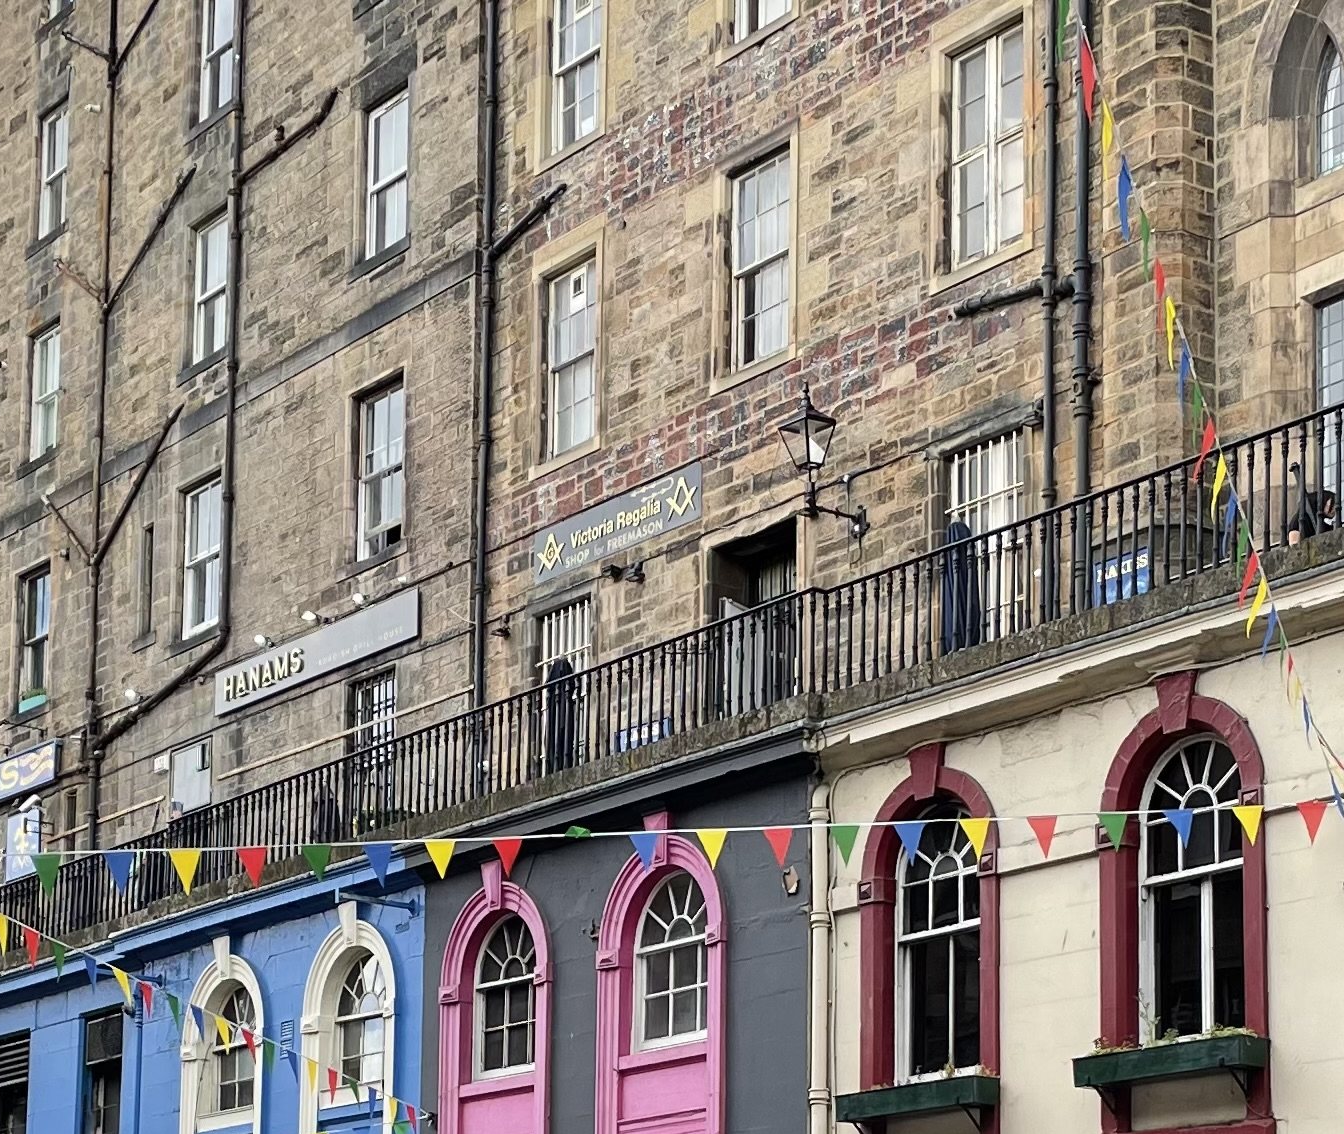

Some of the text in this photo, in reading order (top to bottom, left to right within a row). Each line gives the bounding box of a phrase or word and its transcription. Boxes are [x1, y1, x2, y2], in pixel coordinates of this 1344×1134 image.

[570, 497, 662, 549] Victoria Regalia
[565, 549, 590, 569] SHOP
[223, 647, 305, 703] HANAMS
